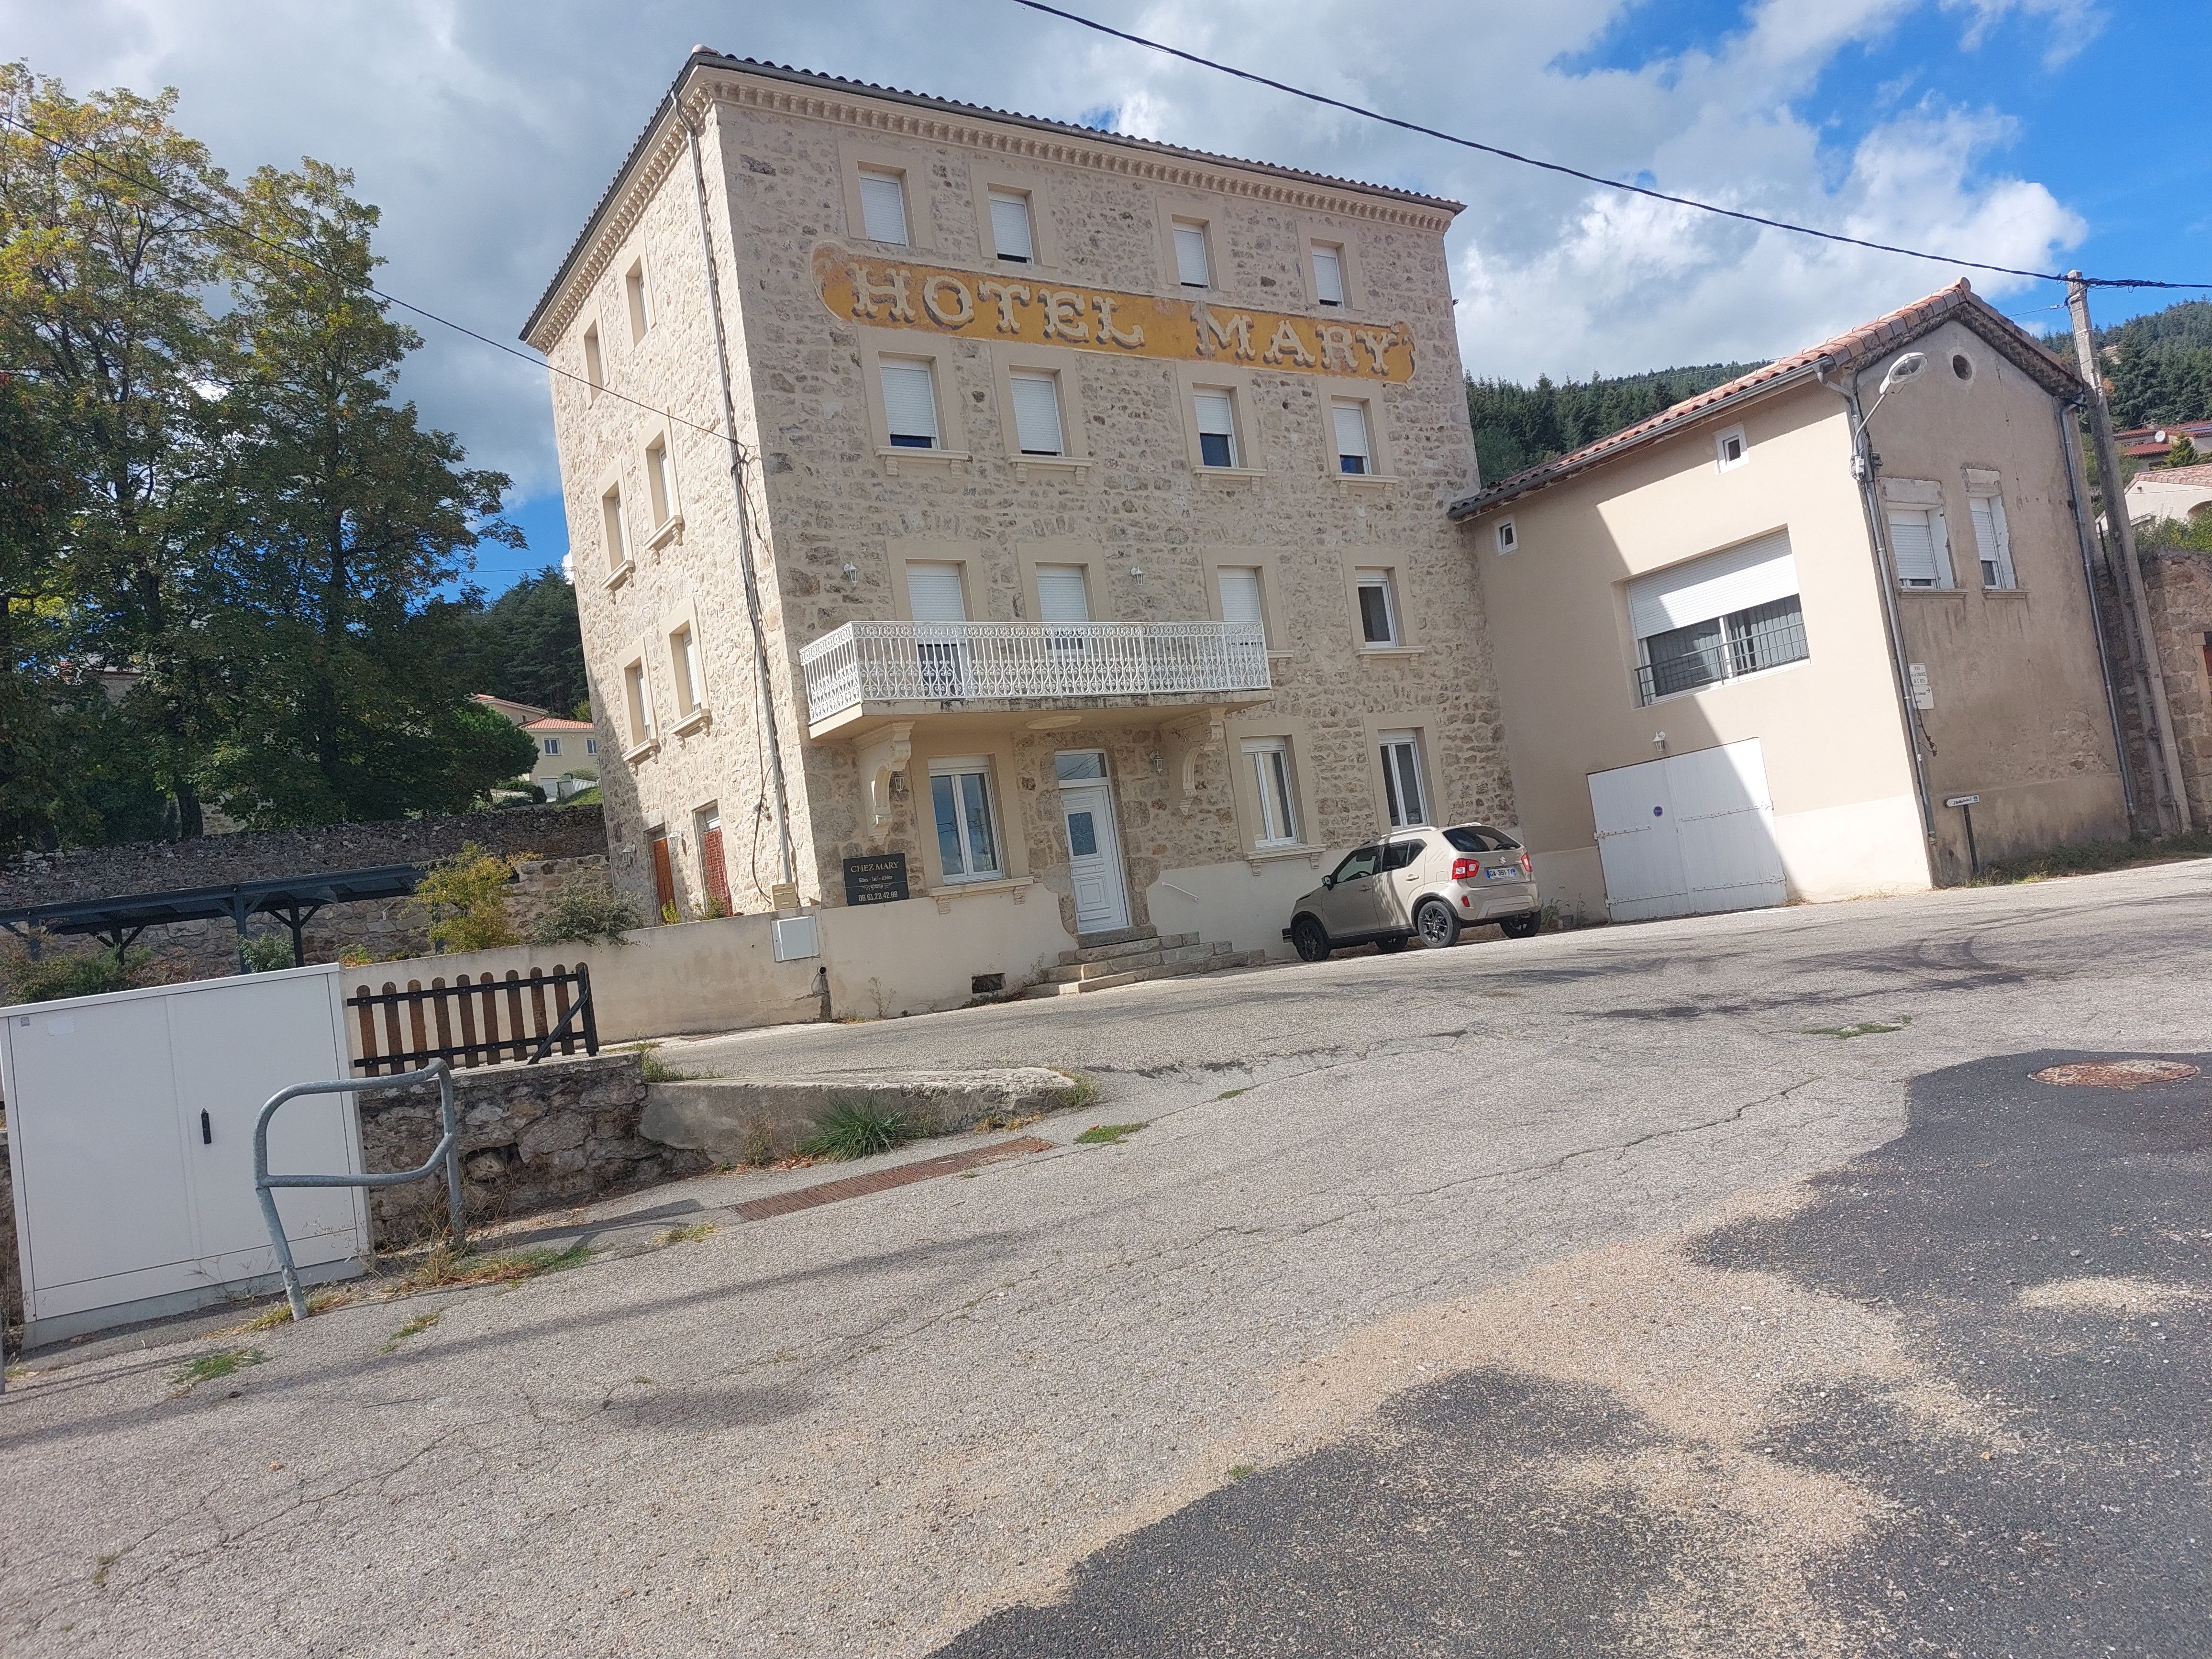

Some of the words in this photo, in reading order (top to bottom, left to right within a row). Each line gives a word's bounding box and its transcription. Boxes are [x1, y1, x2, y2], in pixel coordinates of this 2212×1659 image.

[846, 262, 1145, 348] HOTEL
[1191, 300, 1398, 376] MARY
[851, 863, 874, 873] CHEZ
[875, 861, 899, 871] MARY
